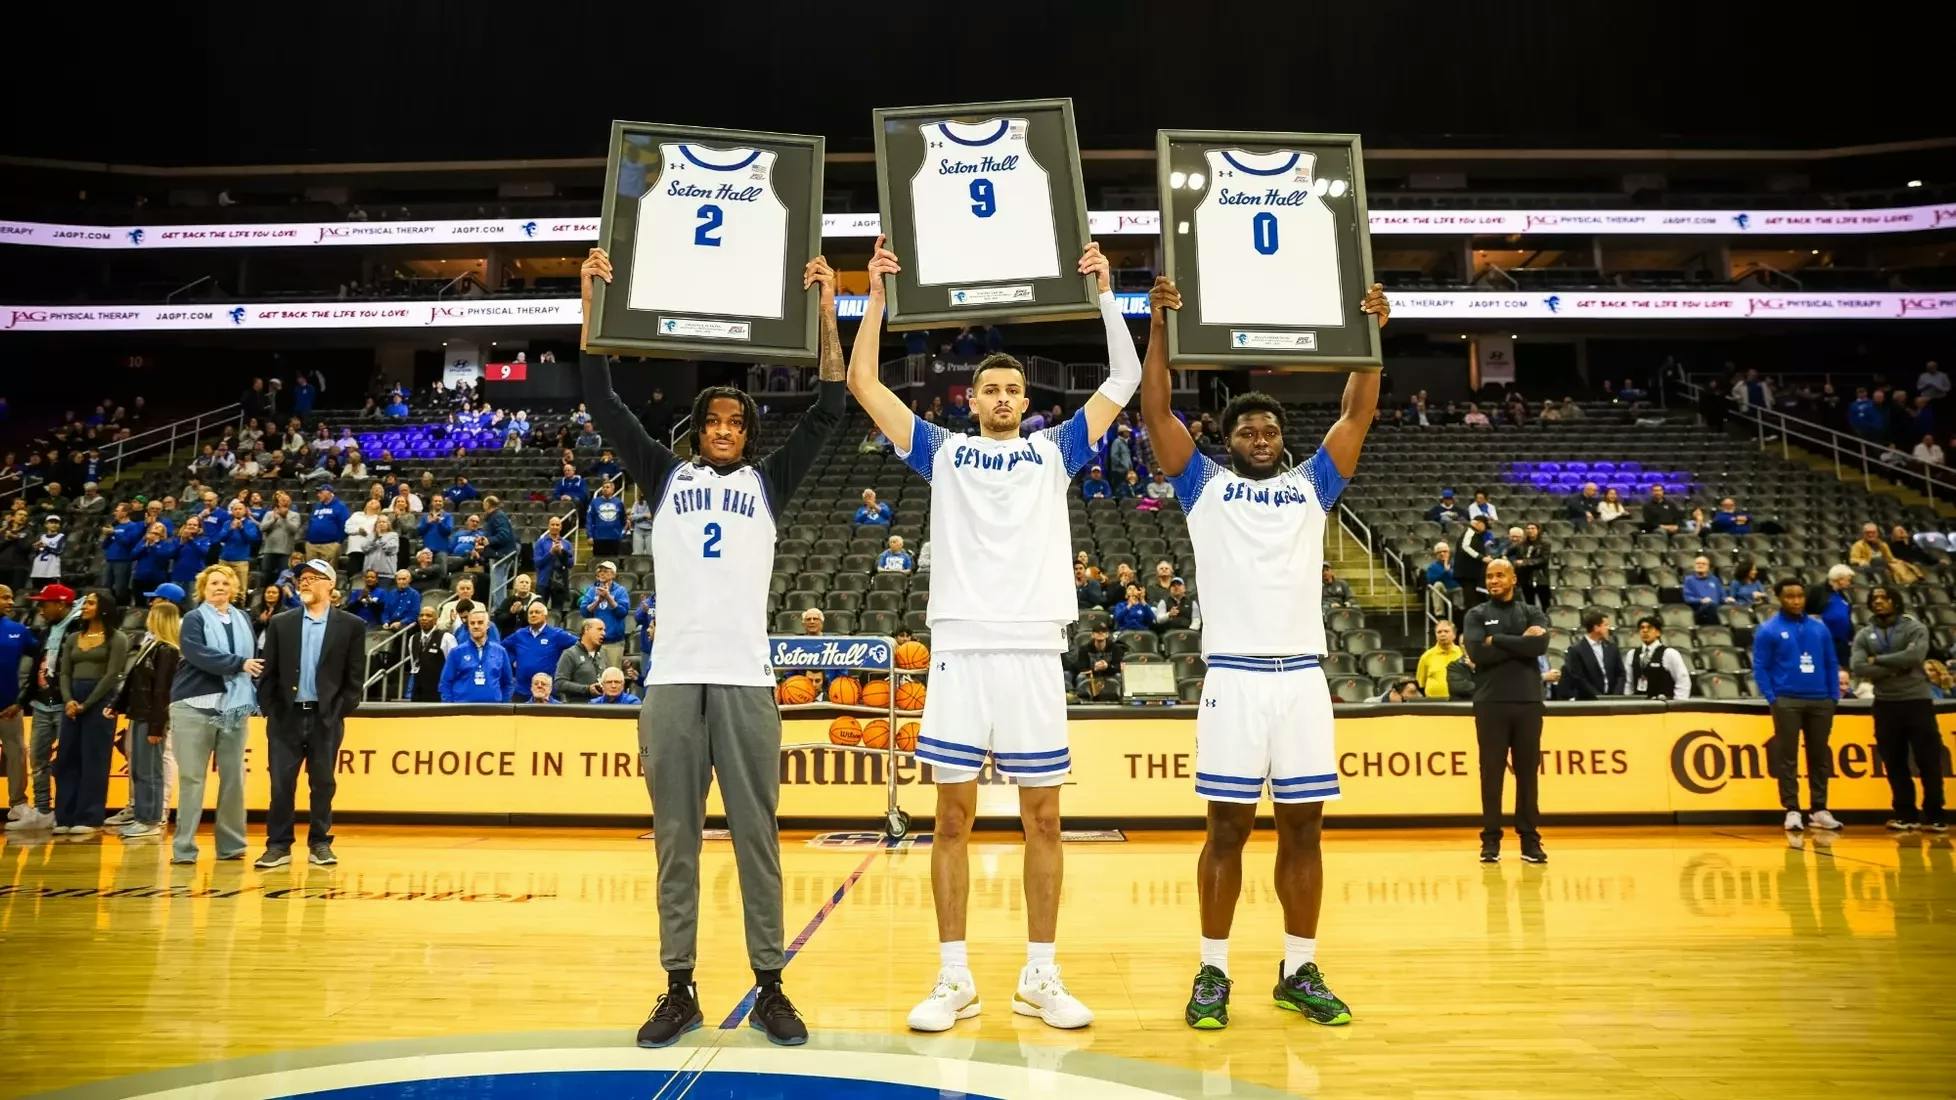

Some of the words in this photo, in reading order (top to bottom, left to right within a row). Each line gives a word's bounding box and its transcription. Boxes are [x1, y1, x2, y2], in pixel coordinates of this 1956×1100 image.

[939, 158, 978, 175] Seton
[980, 155, 1019, 172] Hall
[667, 180, 712, 198] Seton
[714, 183, 763, 202] Hall
[969, 178, 996, 218] 9
[1219, 188, 1262, 205] Seton
[1264, 189, 1308, 206] Hall
[0, 226, 34, 235] ERAPY
[53, 231, 111, 240] JAGPT.COM
[314, 227, 350, 243] JAG
[396, 226, 435, 234] THERAPY
[451, 226, 504, 234] JAGPT.COM
[552, 224, 571, 232] GET
[694, 204, 723, 247] 2
[1253, 212, 1279, 255] 0
[5, 311, 48, 328] JAG
[51, 312, 95, 320] PHYSICAL
[98, 312, 140, 320] THERAPY
[425, 307, 464, 325] JAG
[517, 306, 560, 314] THERAPY
[501, 365, 511, 380] 9
[673, 487, 712, 515] SETON
[722, 488, 755, 518] HALL
[703, 522, 722, 558] 2
[774, 642, 820, 666] Seton
[820, 641, 868, 666] Hall
[392, 750, 515, 776] CHOICE
[532, 751, 563, 776] IN
[1124, 753, 1190, 779] THE
[1339, 751, 1468, 777] CHOICE
[1540, 750, 1628, 775] TIRES
